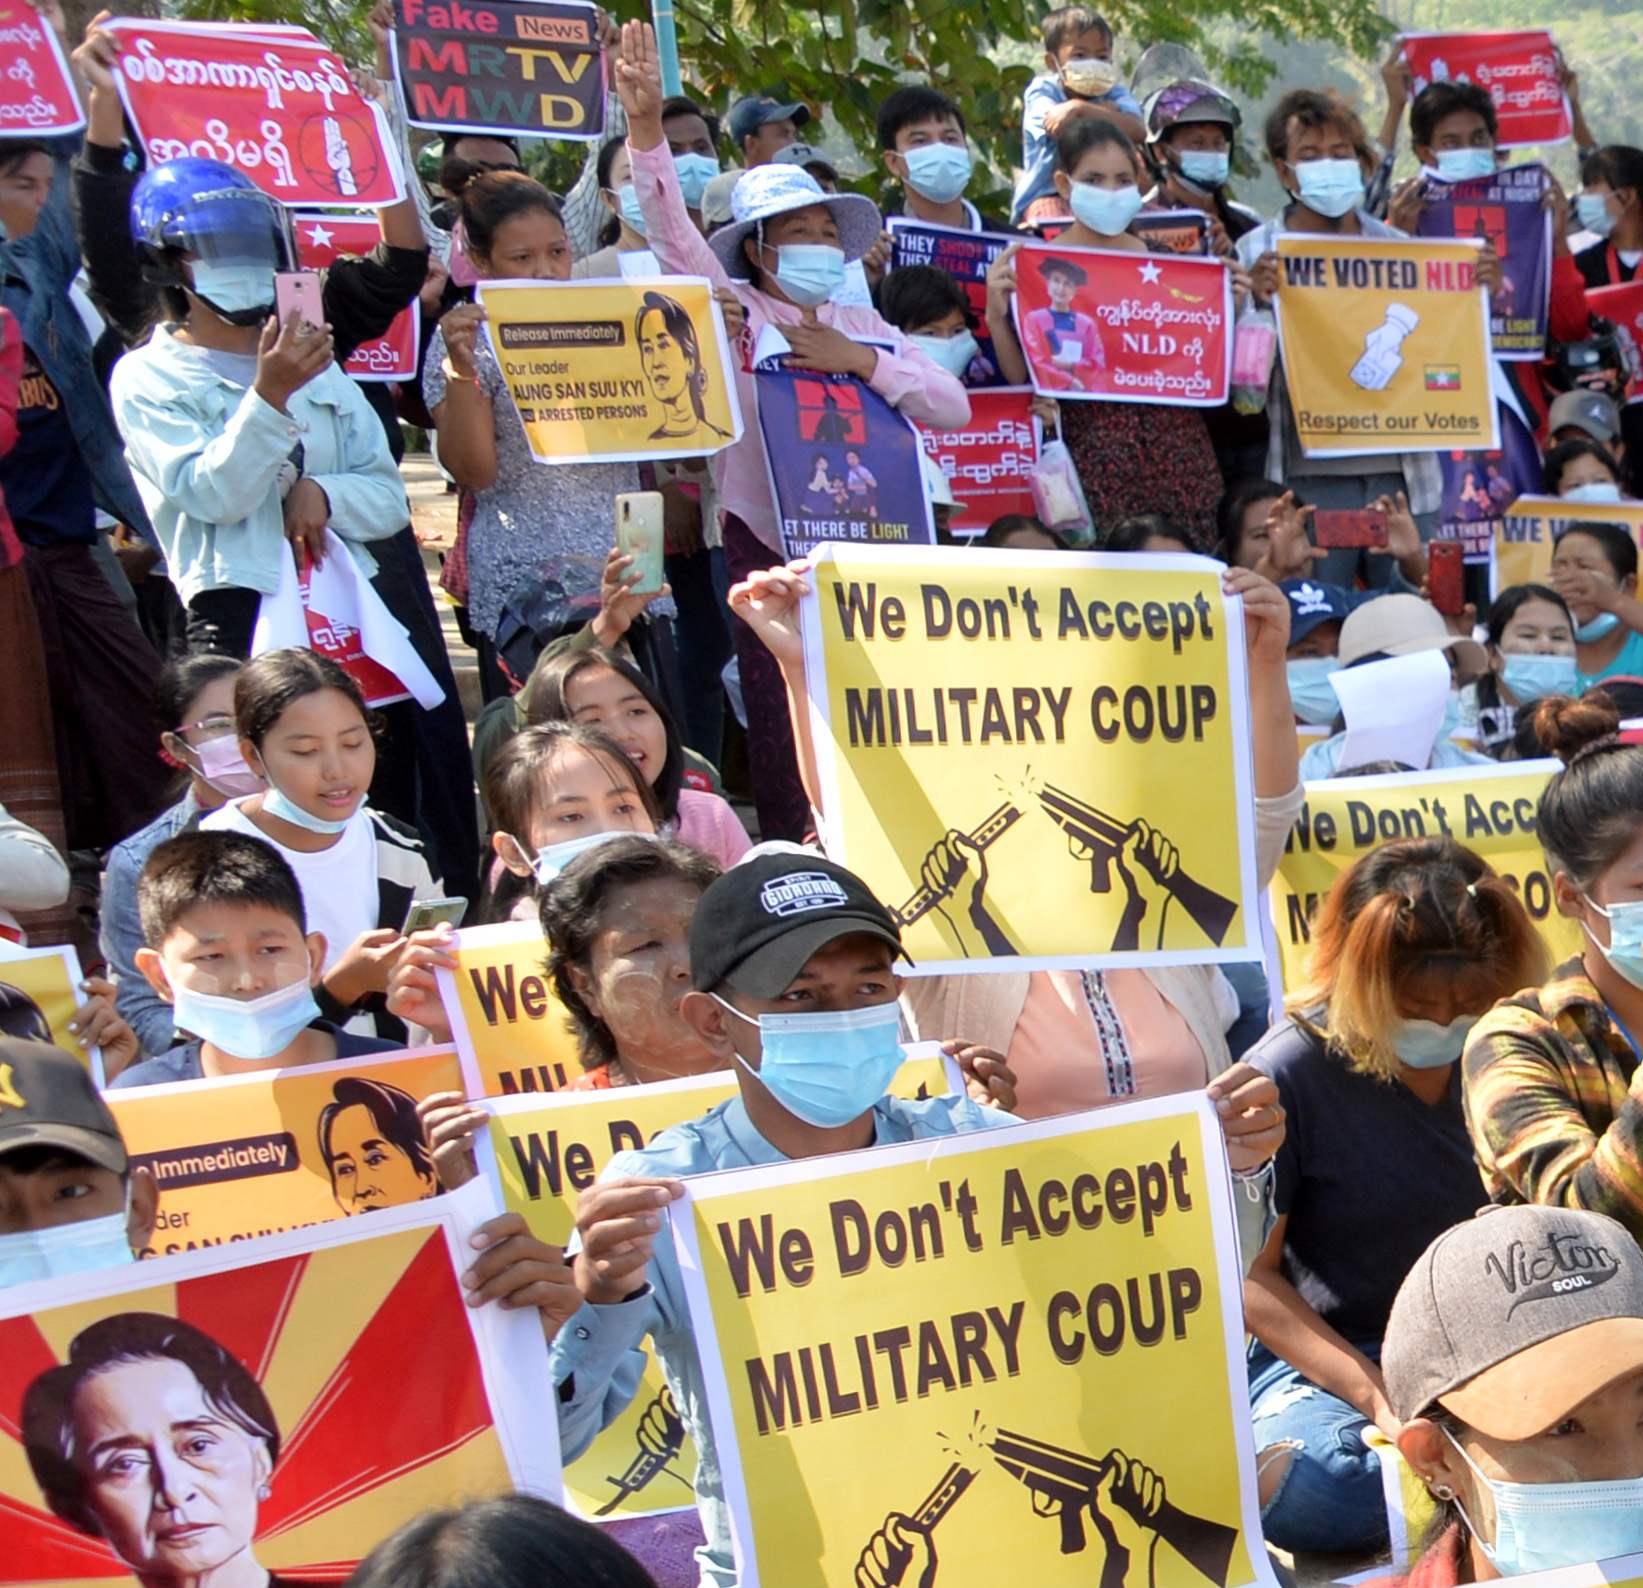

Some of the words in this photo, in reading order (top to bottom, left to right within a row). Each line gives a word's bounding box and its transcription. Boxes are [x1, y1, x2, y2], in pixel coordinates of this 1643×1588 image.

[403, 0, 498, 32] Fake
[523, 17, 584, 39] News
[407, 38, 592, 84] MRTV
[413, 83, 585, 128] MWD
[149, 119, 298, 187] အလိမရှိ
[899, 232, 936, 254] THEY
[1284, 256, 1327, 288] WE
[1332, 258, 1418, 289] VOTED
[1426, 260, 1475, 291] NLD
[504, 327, 549, 342] Release
[550, 325, 620, 342] Immediately
[1122, 332, 1177, 355] NLD
[506, 361, 527, 376] Our
[528, 360, 569, 375] Leader
[514, 383, 553, 402] AUNG
[555, 381, 586, 400] SAN
[590, 381, 618, 399] SUU
[621, 380, 645, 398] KYI
[538, 406, 594, 422] ARRESTED
[596, 405, 648, 420] PERSONS
[1299, 411, 1380, 430] Respect
[1386, 414, 1418, 429] our
[1425, 412, 1480, 430] Votes
[803, 520, 848, 539] THERE
[850, 521, 869, 539] BE
[872, 522, 909, 541] LIGHT
[1501, 516, 1543, 542] WE
[833, 581, 907, 642] We
[924, 582, 1042, 640] Don't
[1057, 588, 1215, 655] Accept
[845, 685, 1073, 748] MILITARY
[1090, 683, 1219, 743] COUP
[1349, 798, 1453, 847] Don't
[1463, 792, 1538, 840] Acc
[469, 962, 549, 1026] We
[154, 1141, 290, 1180] Immediately
[511, 1128, 601, 1200] We
[155, 1208, 191, 1231] der
[717, 1214, 815, 1298] We
[831, 1177, 984, 1278] Don't
[1000, 1140, 1194, 1247] Accept
[1552, 1274, 1592, 1293] SOUL
[746, 1300, 1027, 1437] MILITARY
[1046, 1266, 1204, 1365] COUP
